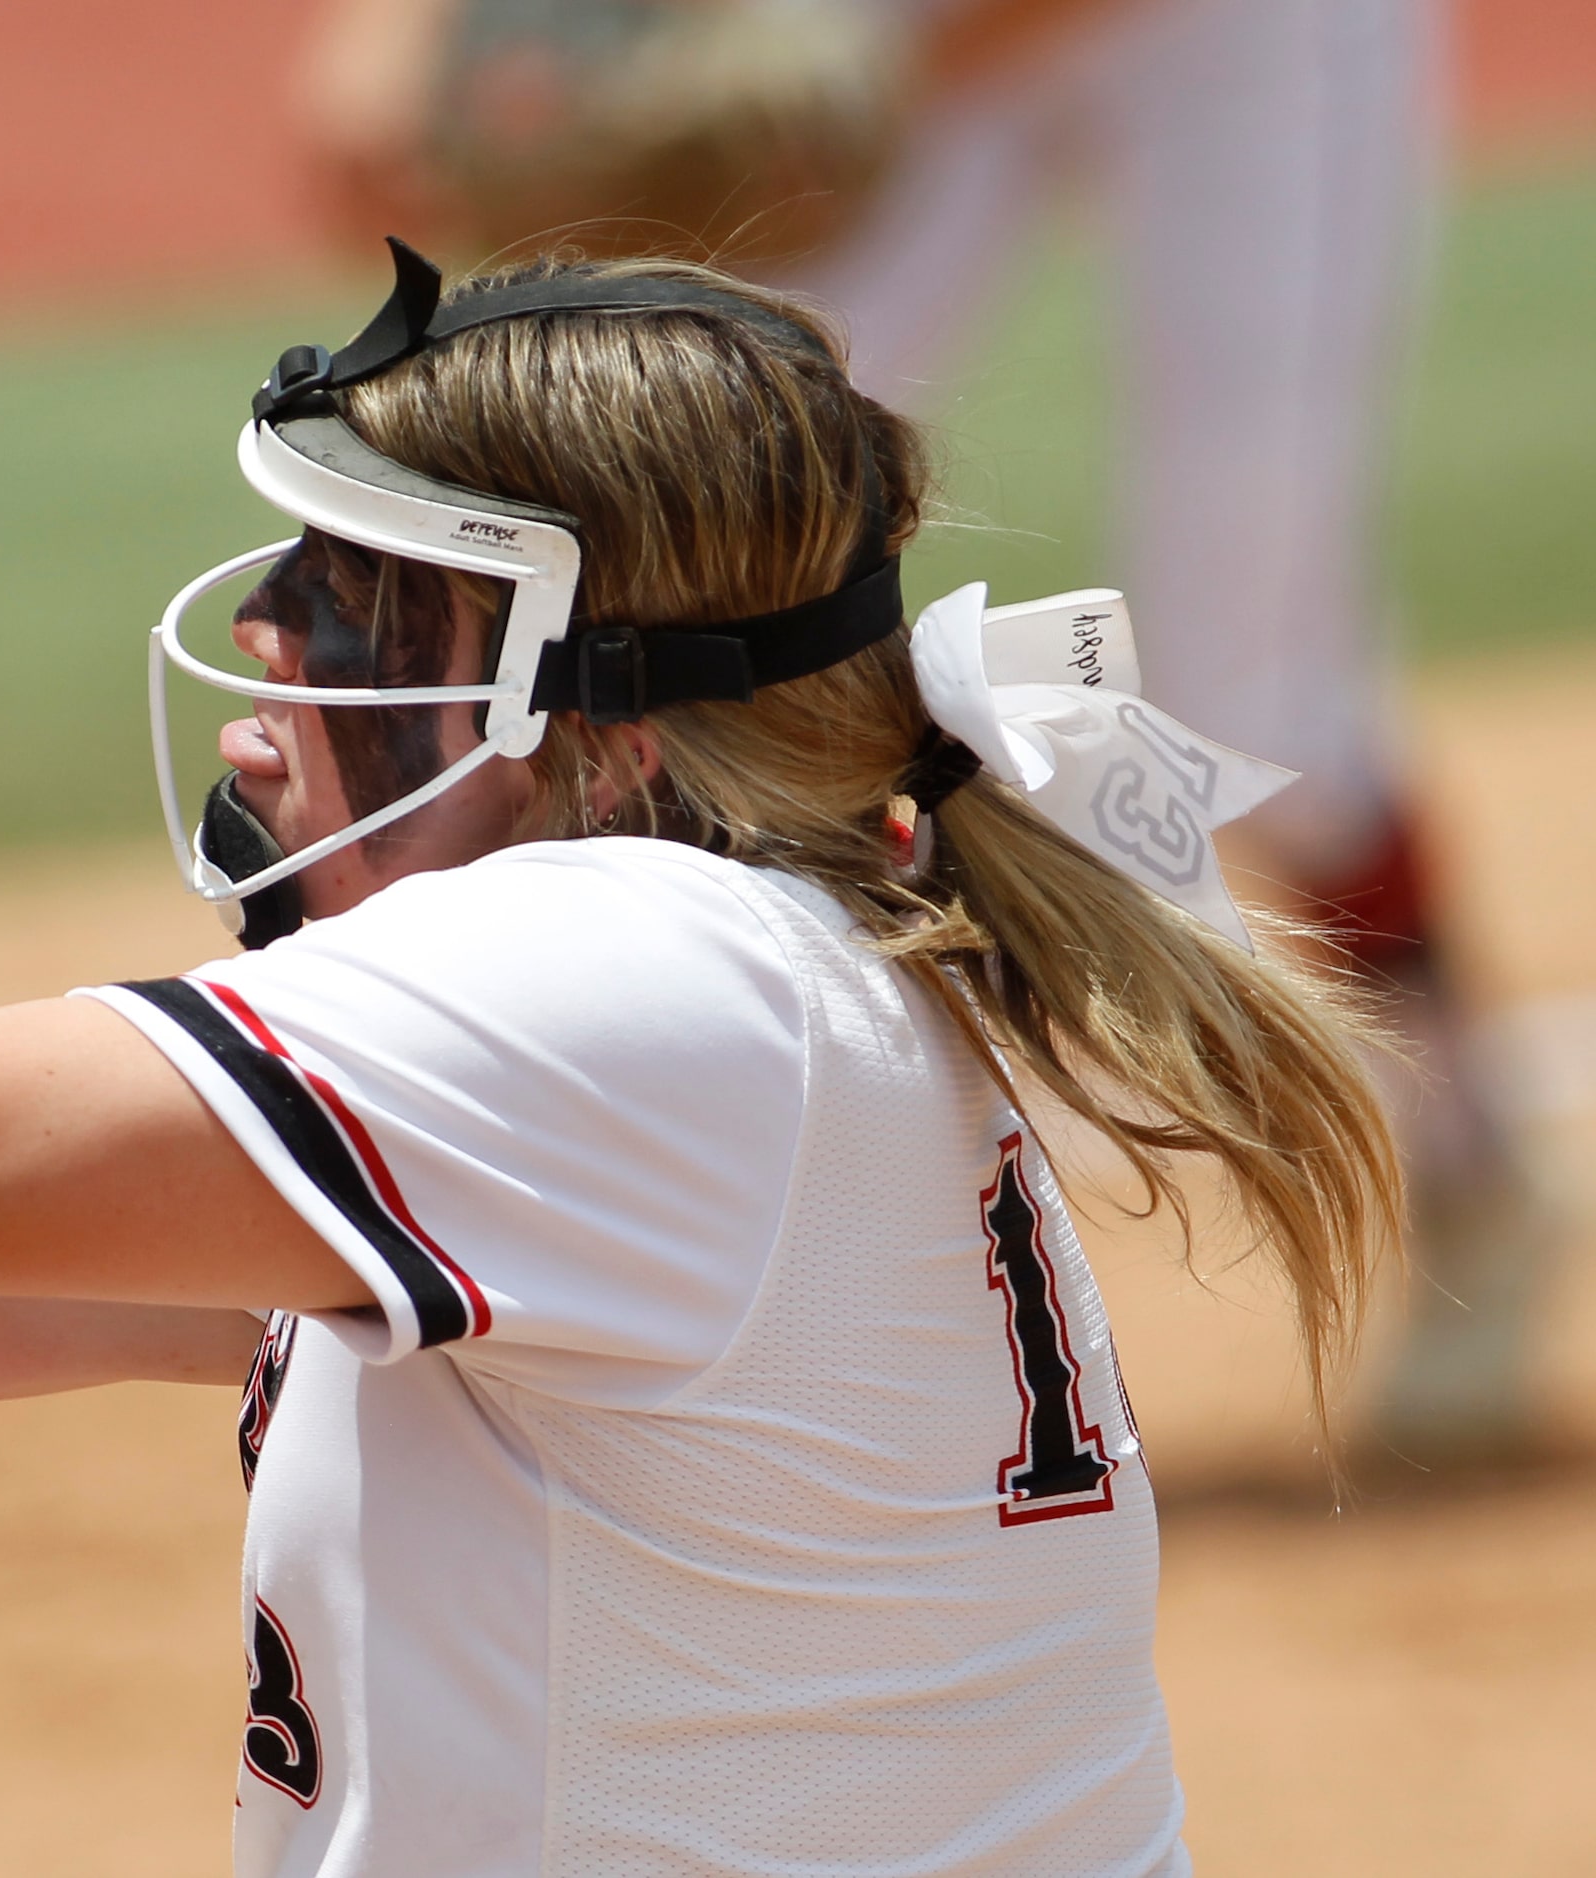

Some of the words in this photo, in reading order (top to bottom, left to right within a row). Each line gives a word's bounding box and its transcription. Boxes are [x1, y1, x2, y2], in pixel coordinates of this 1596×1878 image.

[459, 519, 520, 541] DEFENSE
[1067, 612, 1112, 687] ndsey
[1089, 702, 1219, 887] 13
[980, 1130, 1151, 1528] 1
[242, 1593, 323, 1810] 3
